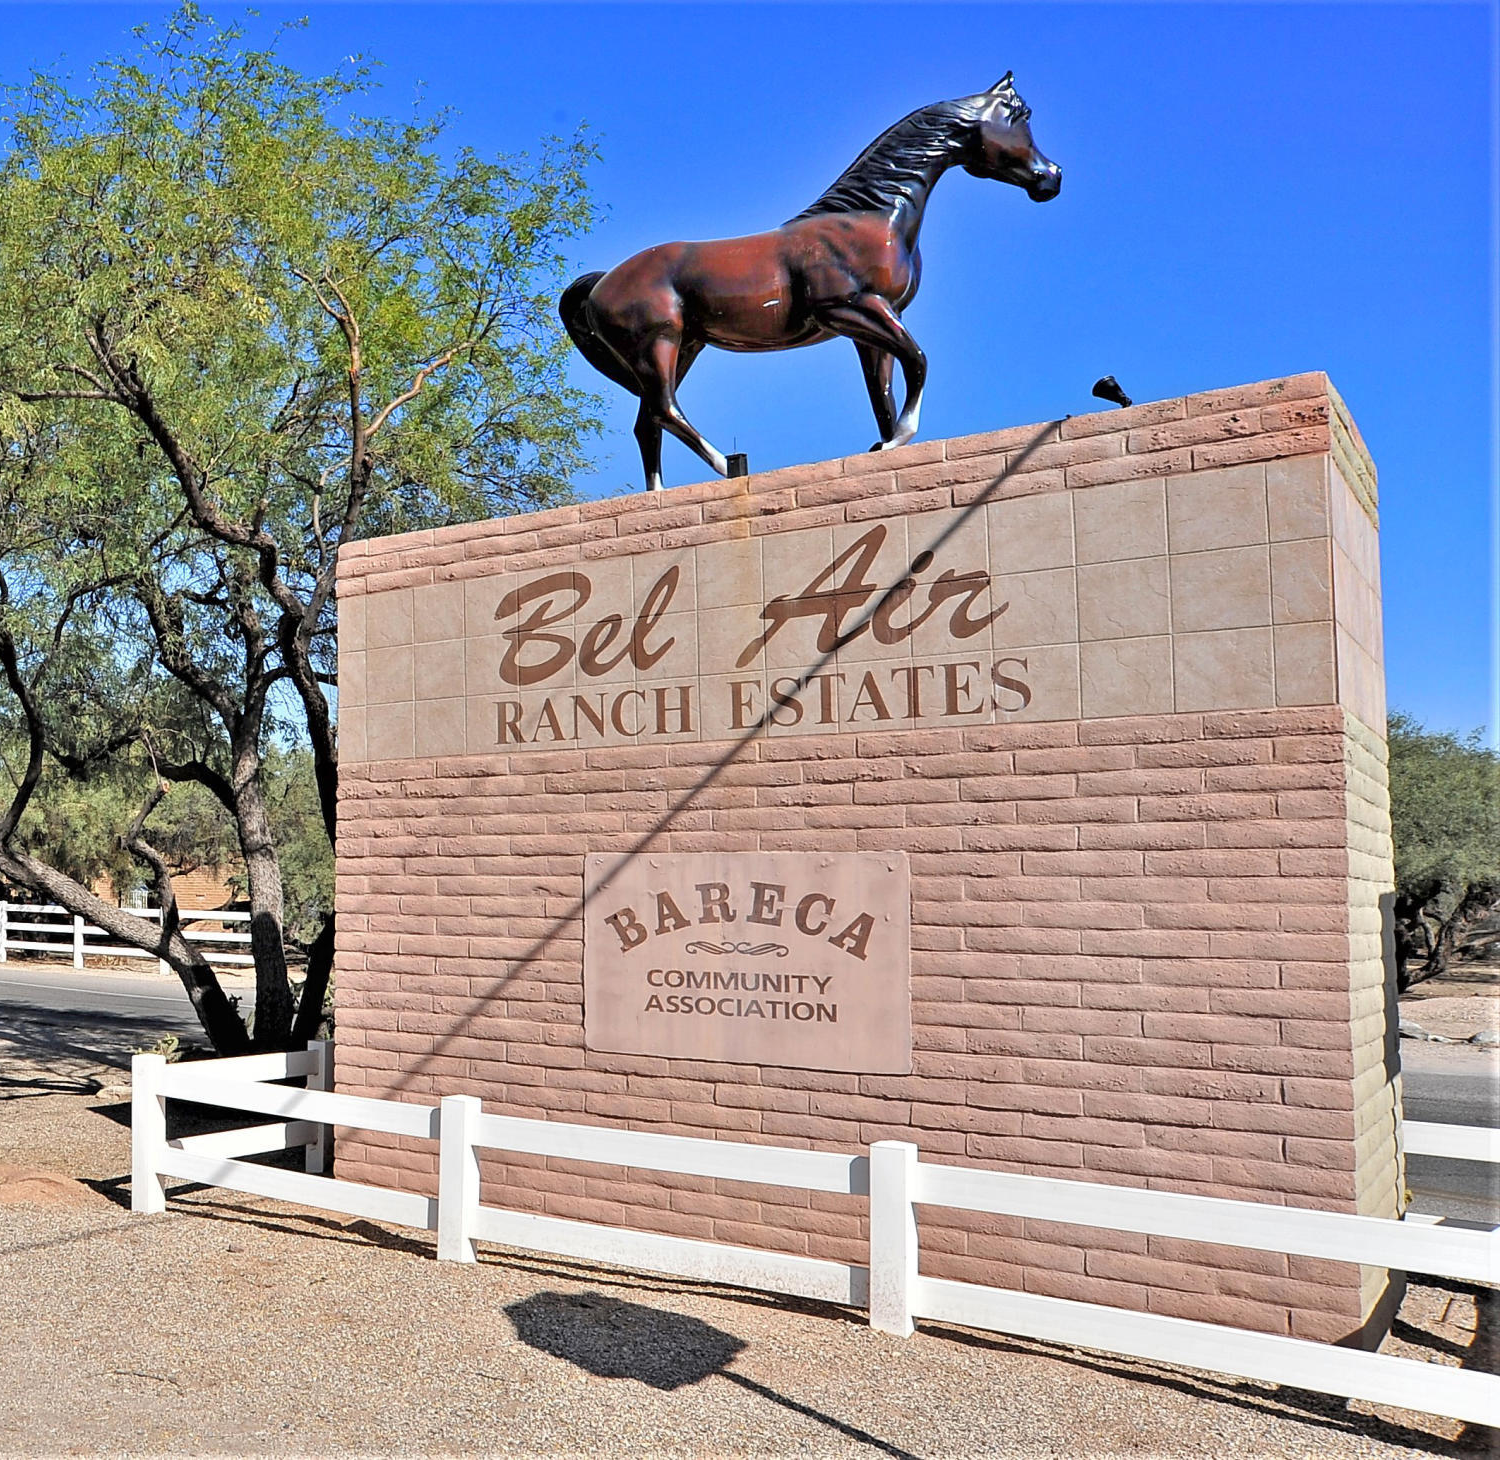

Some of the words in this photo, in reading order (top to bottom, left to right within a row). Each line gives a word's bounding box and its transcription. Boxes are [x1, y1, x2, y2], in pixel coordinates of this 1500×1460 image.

[494, 565, 680, 685] Bel
[735, 523, 1010, 669] Air
[494, 685, 695, 745] RANCH
[727, 657, 1033, 730] ESTATES
[604, 880, 876, 961] BARECA
[643, 994, 838, 1023] ASSOCIATION
[646, 968, 834, 995] COMMUNITY
